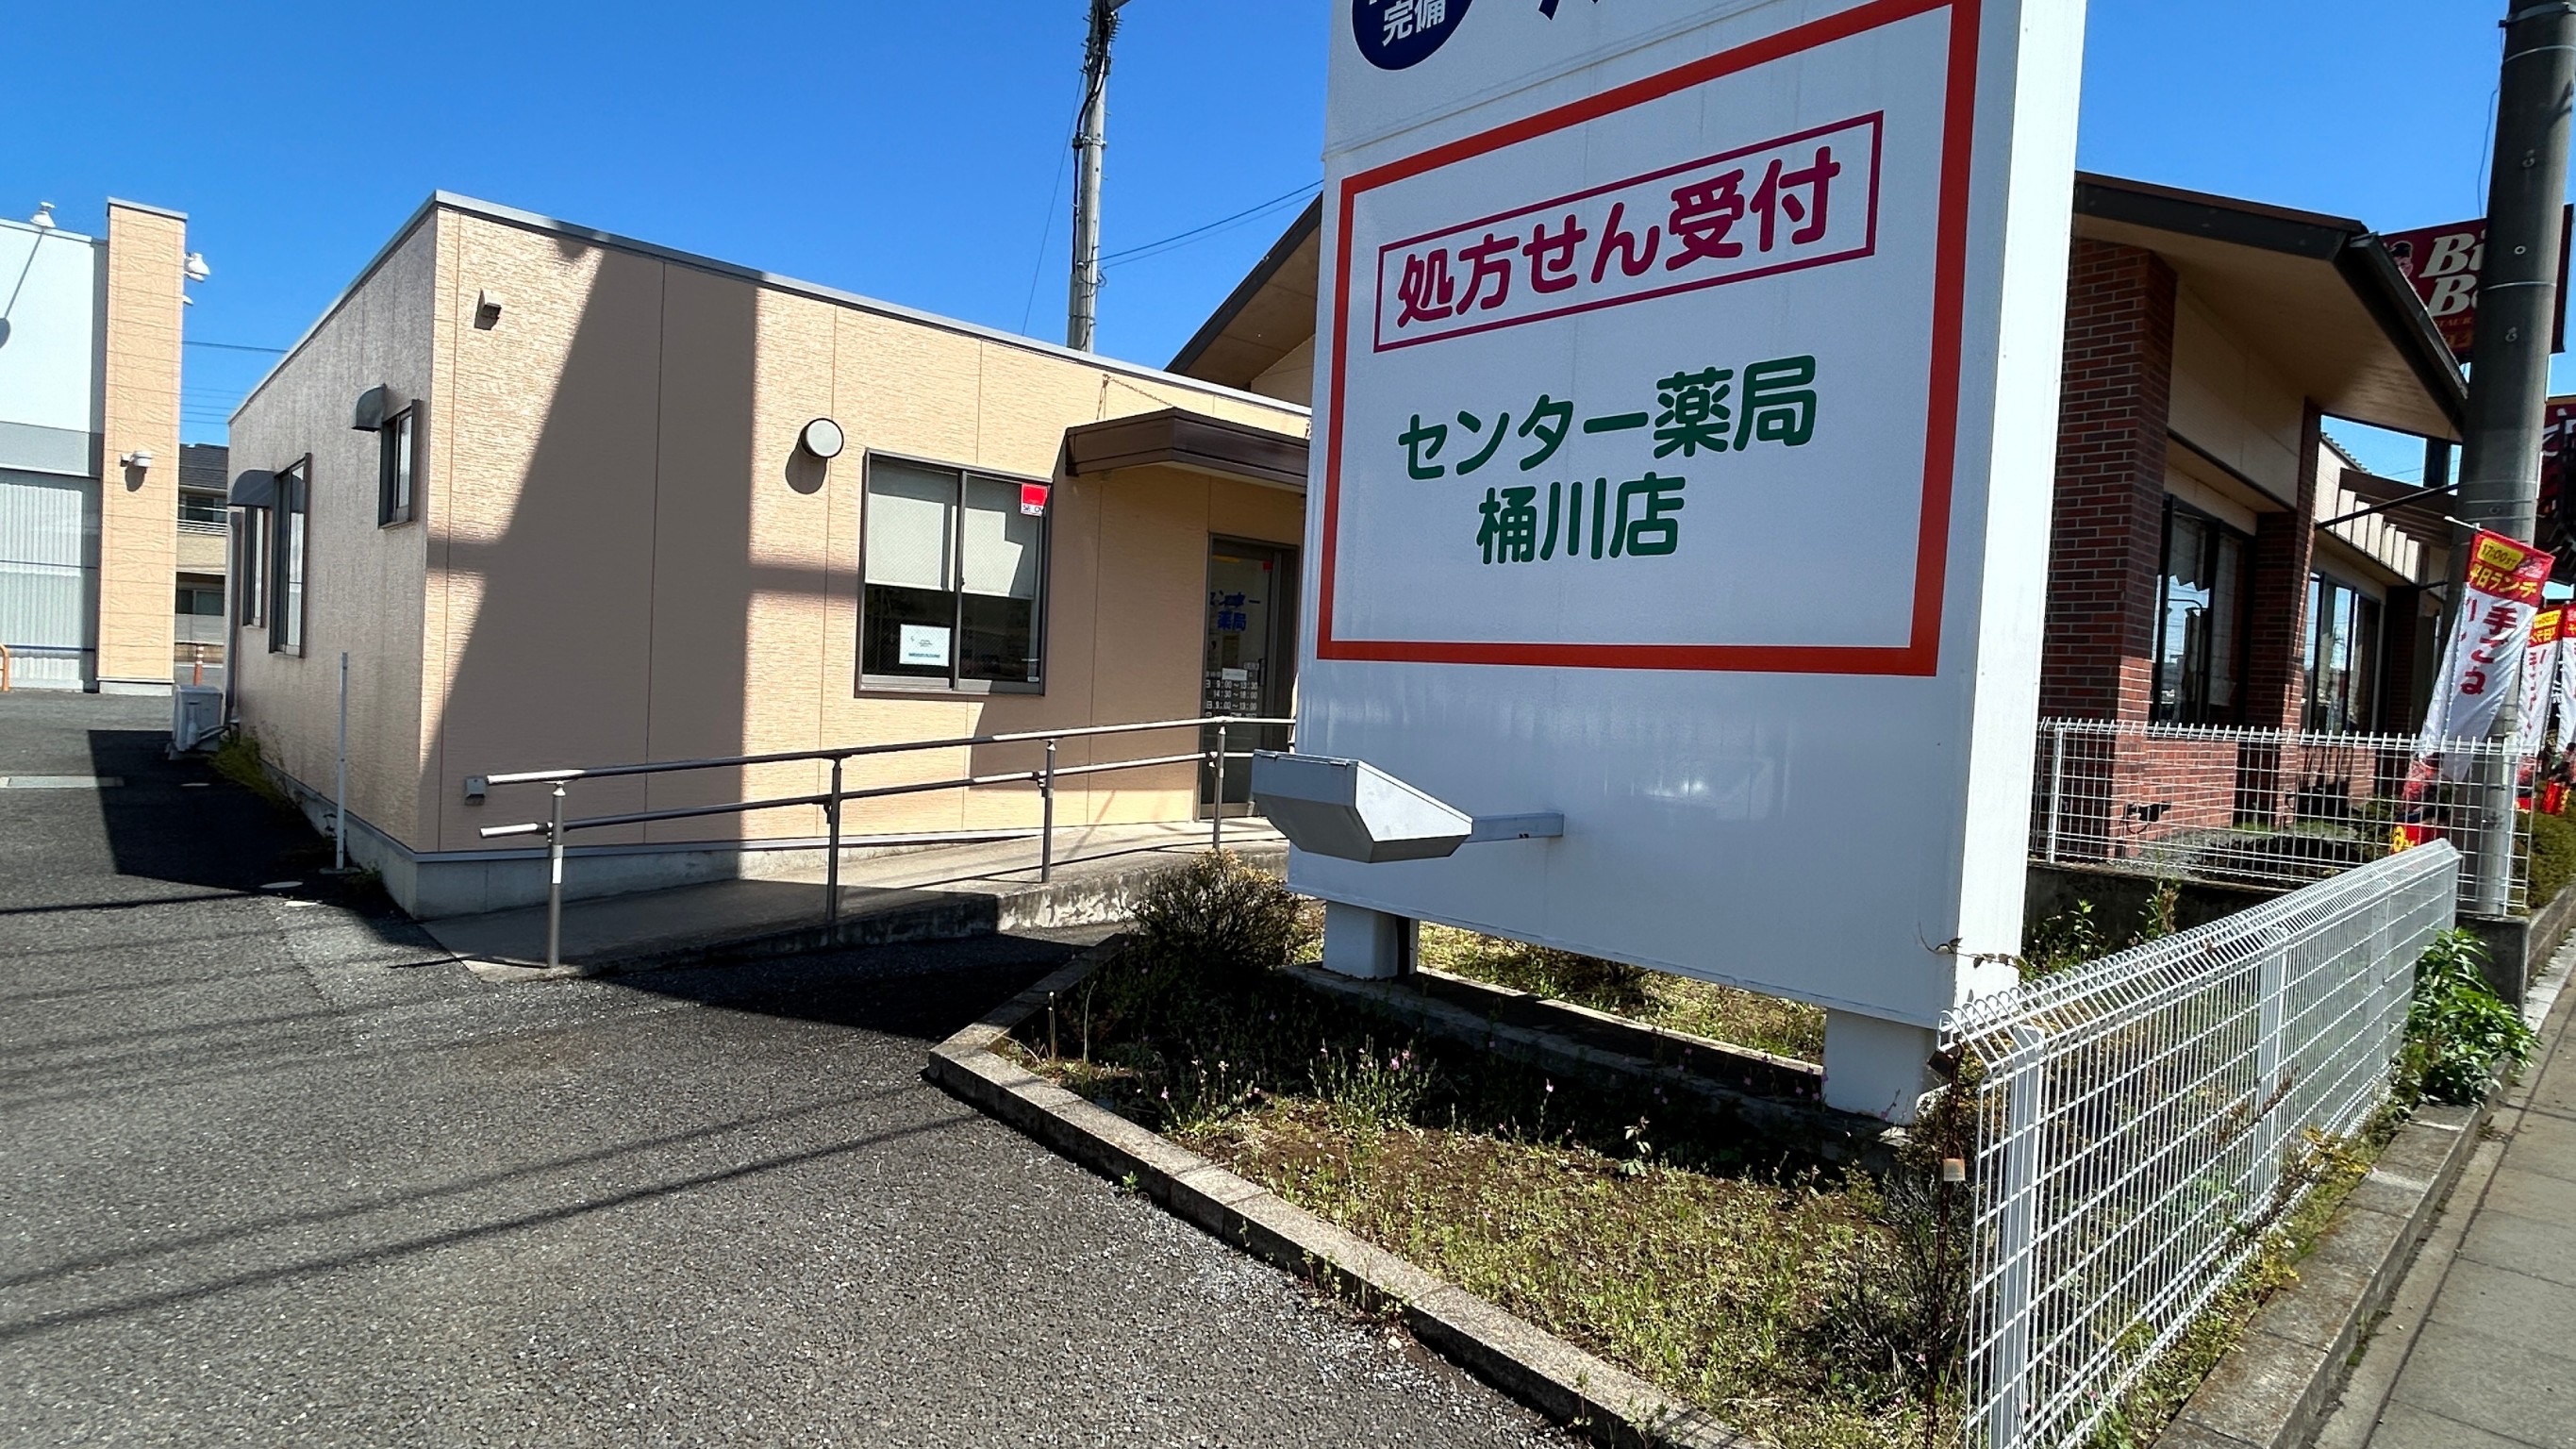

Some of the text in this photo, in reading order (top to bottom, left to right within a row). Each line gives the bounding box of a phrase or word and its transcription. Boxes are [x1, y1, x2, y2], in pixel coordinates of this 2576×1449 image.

[1382, 0, 1445, 47] 完備
[1396, 146, 1840, 328] 処方せん受付
[2418, 228, 2486, 279] Bi
[1397, 354, 1818, 482] センター薬局
[1475, 471, 1687, 565] 桶川店
[2468, 563, 2538, 599] 平日ランチ
[1217, 610, 1247, 631] 薬局
